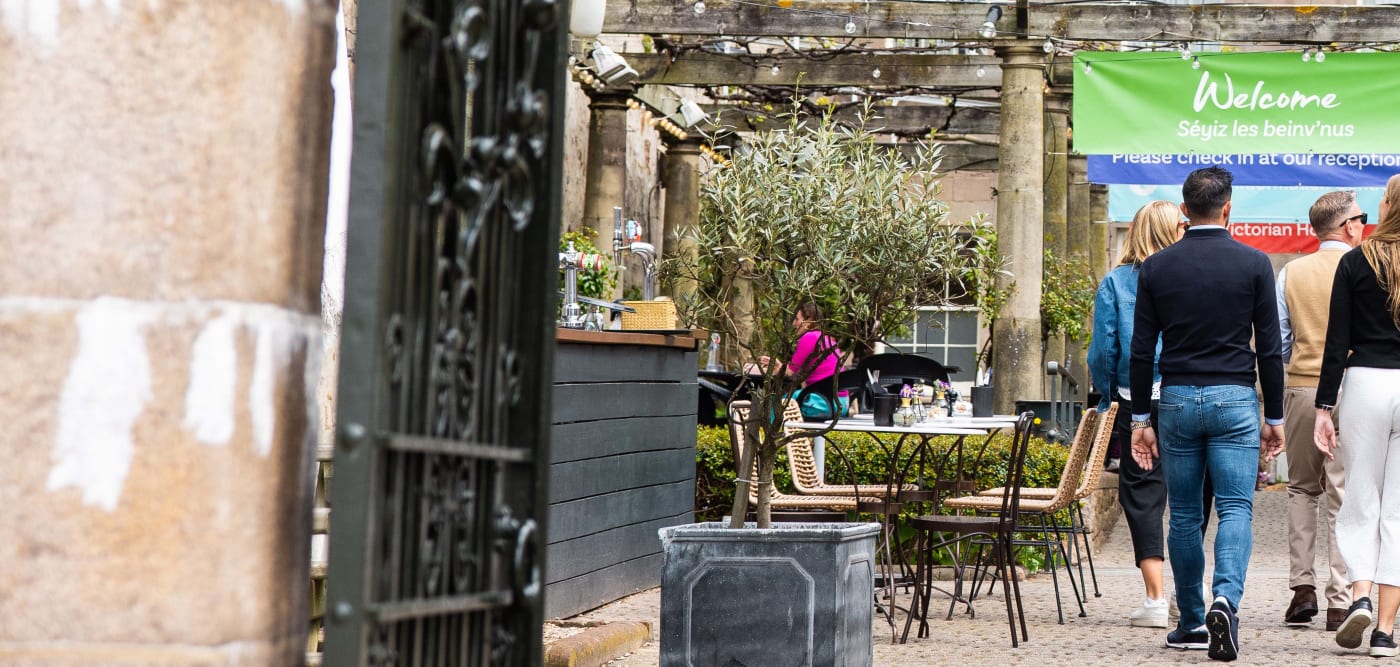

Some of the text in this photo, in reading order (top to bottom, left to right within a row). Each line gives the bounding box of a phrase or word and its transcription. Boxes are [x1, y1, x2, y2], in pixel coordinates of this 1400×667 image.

[1193, 70, 1341, 112] Welcome
[1177, 119, 1355, 141] Séyiz les beinv’nus
[1112, 153, 1172, 164] Please
[1177, 153, 1234, 165] check
[1237, 153, 1254, 165] in
[1258, 153, 1279, 166] at
[1283, 153, 1315, 166] our
